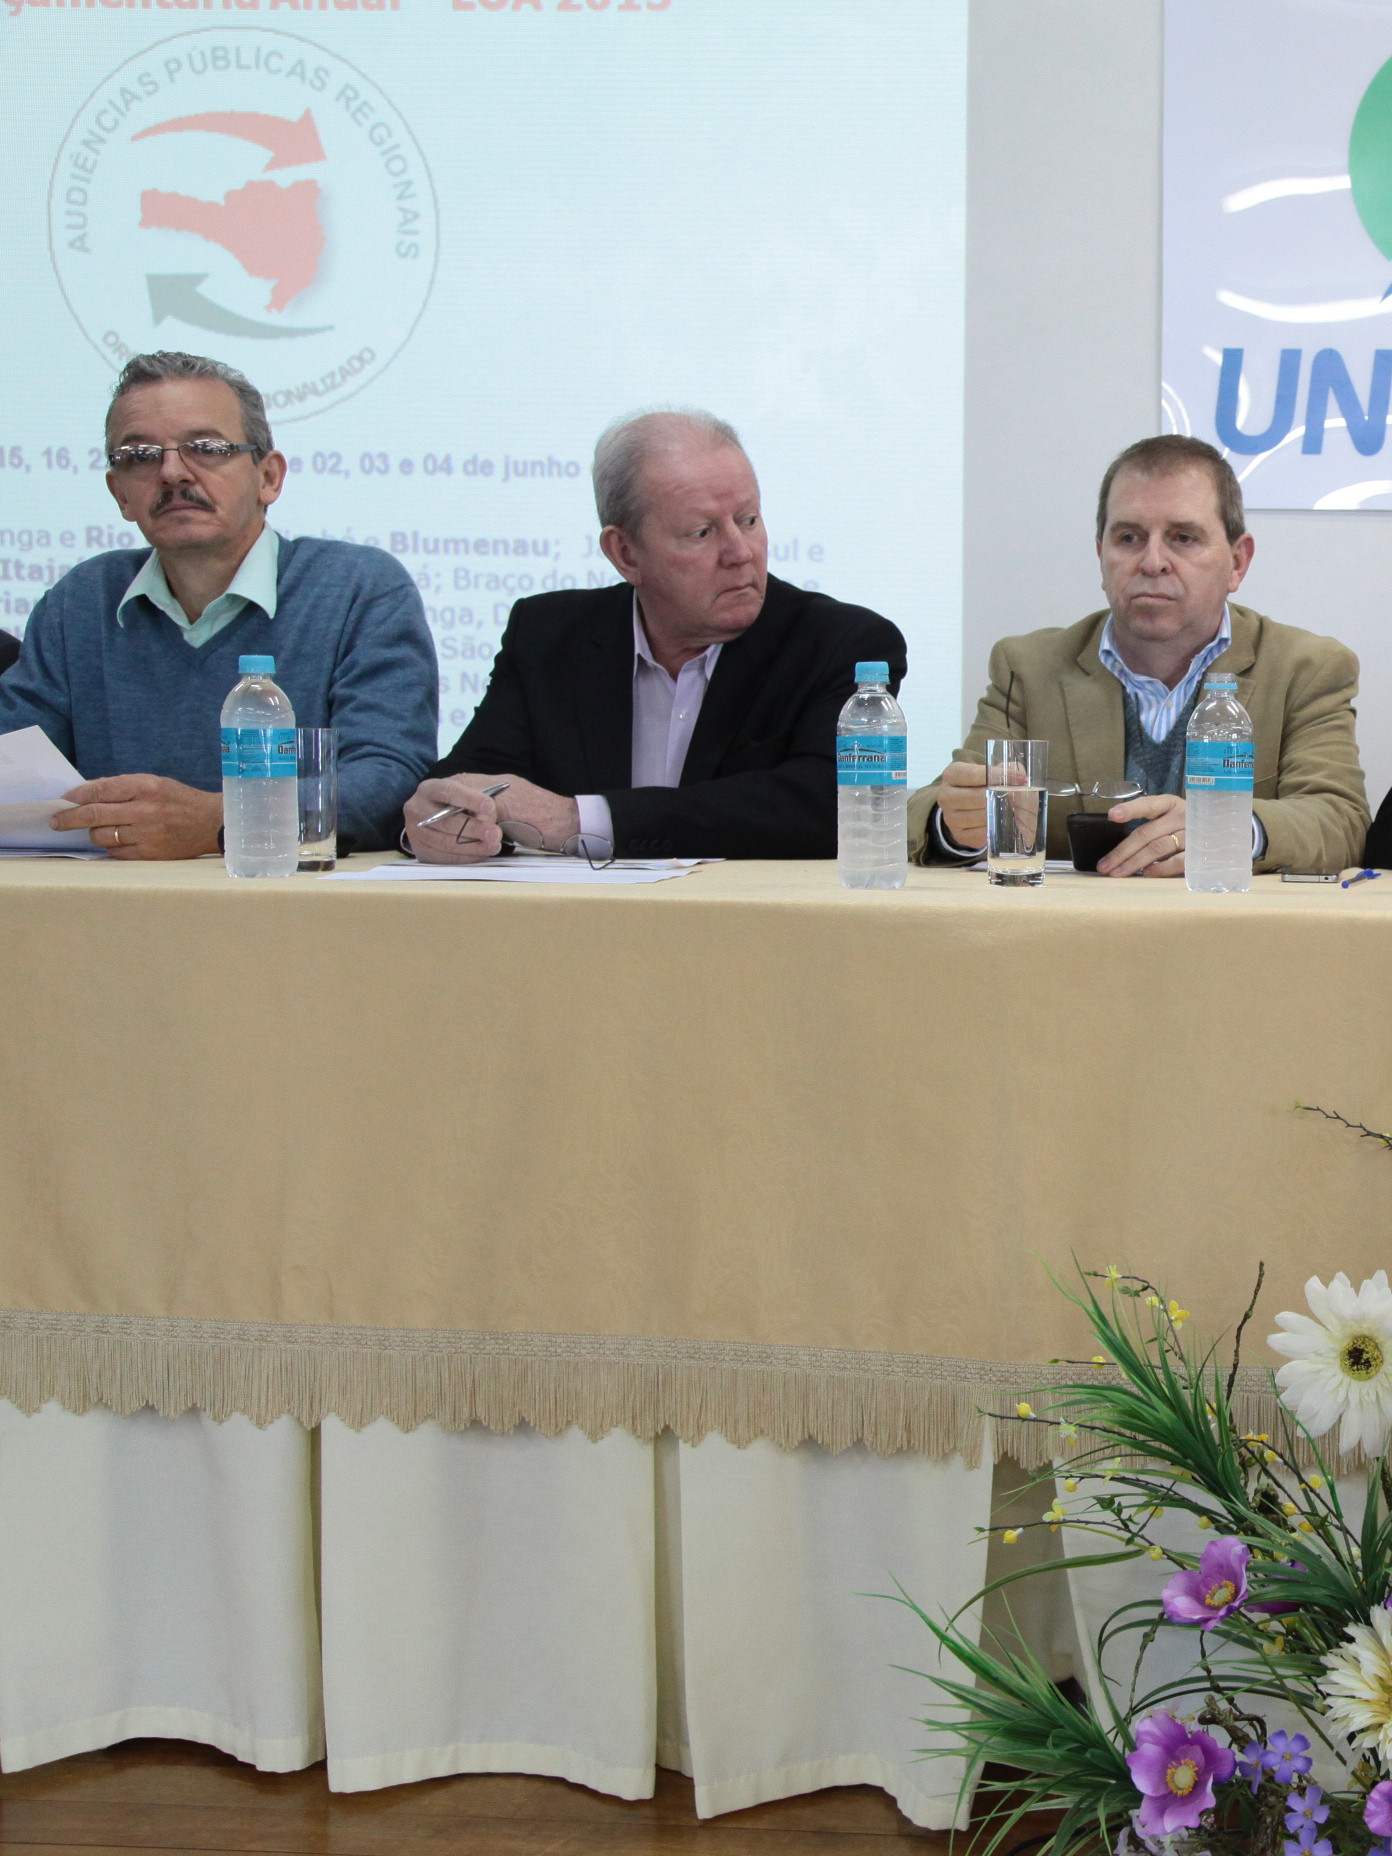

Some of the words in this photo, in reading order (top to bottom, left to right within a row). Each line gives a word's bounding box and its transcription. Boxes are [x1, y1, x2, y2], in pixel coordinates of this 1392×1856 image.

[65, 71, 160, 254] AUDIÊNCIAS
[163, 45, 331, 92] PÚBLICAS
[334, 83, 421, 260] REGIONAIS
[41, 447, 78, 474] 16,
[88, 447, 108, 471] 2
[312, 452, 350, 479] 02,
[360, 452, 390, 475] 03
[399, 457, 414, 475] e
[423, 453, 454, 476] 04
[463, 454, 495, 477] de
[501, 455, 581, 483] junho
[60, 530, 76, 548] e
[85, 525, 135, 549] Rio
[391, 531, 561, 558] Blumenau;
[806, 544, 826, 562] e
[454, 567, 535, 596] Braço
[541, 569, 577, 590] do
[441, 635, 494, 660] São
